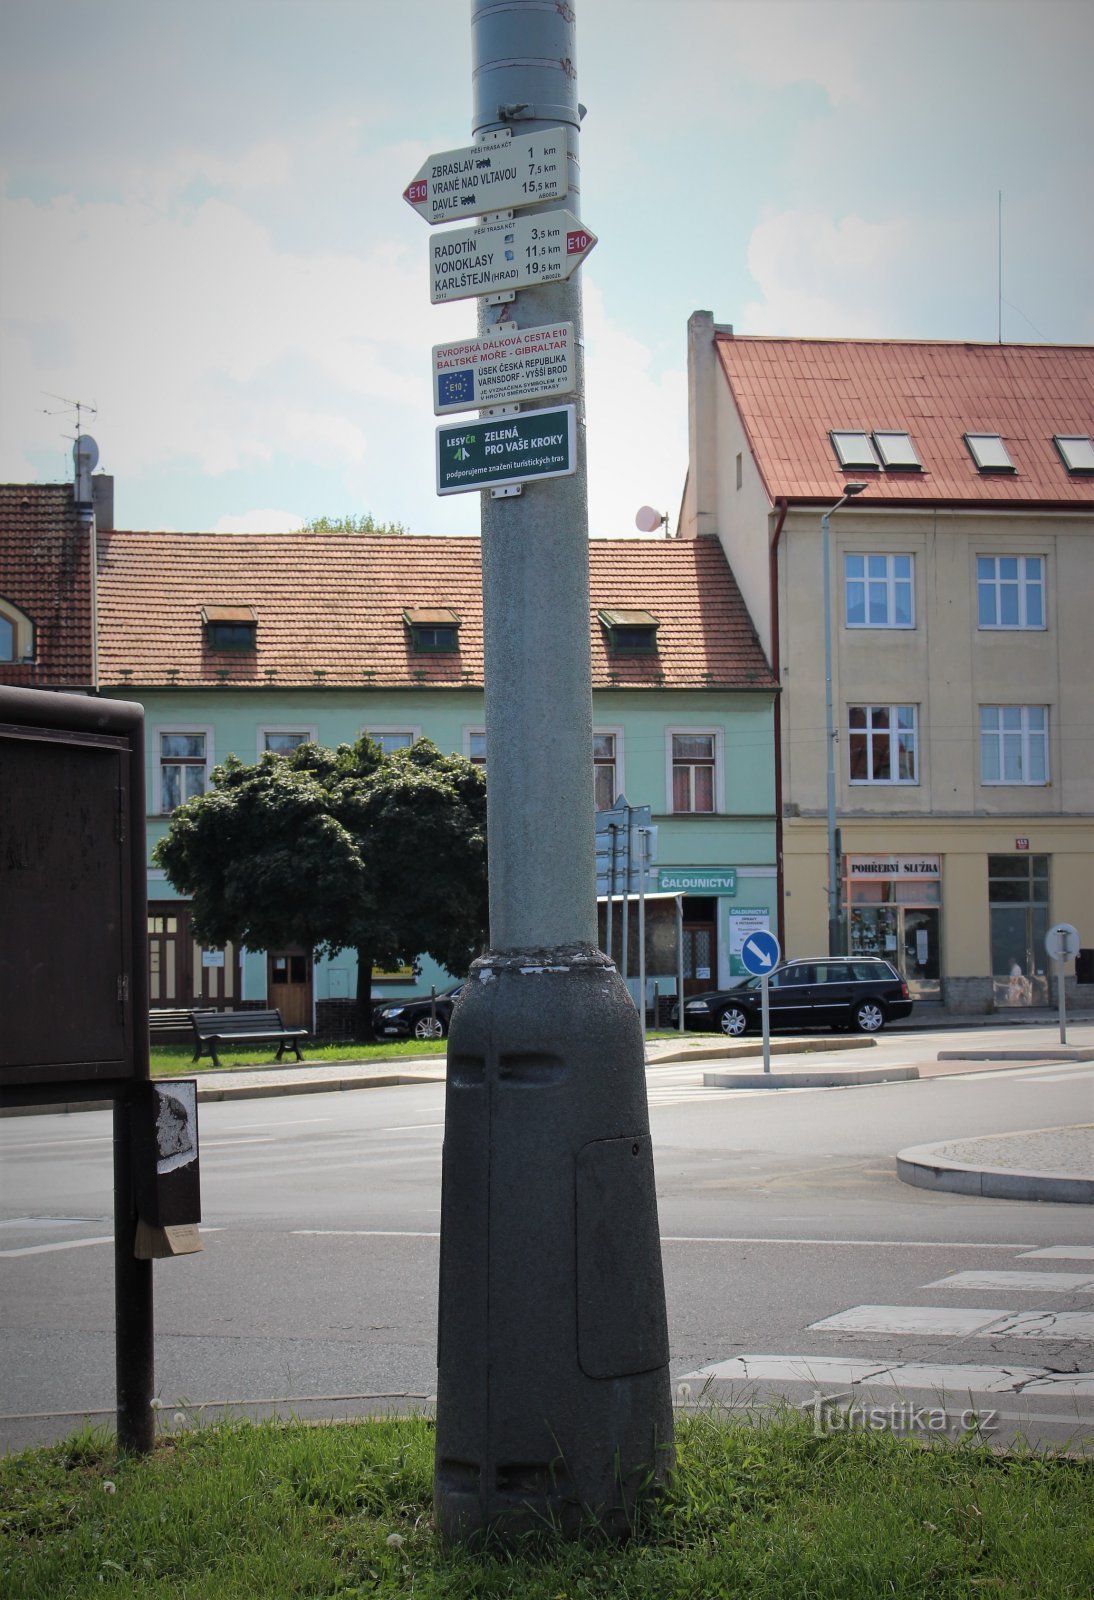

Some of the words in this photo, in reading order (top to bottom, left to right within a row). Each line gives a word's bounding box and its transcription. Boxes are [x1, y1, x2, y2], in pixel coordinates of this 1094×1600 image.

[483, 143, 501, 152] TRASA
[528, 147, 533, 158] 1
[543, 147, 556, 155] km
[432, 159, 474, 178] ZBRASLAV
[528, 163, 542, 175] 7,5
[544, 164, 556, 173] km
[432, 176, 460, 195] VRANÉ
[461, 175, 479, 189] NAD
[480, 167, 517, 185] VLTAVOU
[522, 180, 542, 193] 15,5
[544, 181, 557, 189] km
[409, 185, 427, 199] E10
[432, 196, 458, 211] DAVLE
[487, 225, 504, 233] TRASA
[531, 228, 546, 240] 3,5
[547, 229, 560, 237] km
[434, 238, 477, 259] RADOTÍN
[567, 236, 587, 250] E10
[525, 244, 546, 258] 11,5
[548, 245, 561, 254] km
[435, 253, 494, 275] VONOKLASY
[525, 262, 546, 275] 19,5
[548, 263, 561, 271] km
[435, 271, 491, 292] KARLŠTEJN
[491, 268, 519, 283] (HRAD)
[437, 342, 481, 359] EVROPSKÁ
[524, 331, 551, 343] CESTA
[552, 328, 567, 338] E10
[437, 352, 478, 369] BALTSKÉ
[480, 350, 507, 362] MOŘE
[515, 340, 567, 356] GIBRALTAR
[478, 365, 498, 376] ÚSEK
[499, 359, 524, 373] ČESKÁ
[525, 354, 567, 368] REPUBLIKA
[478, 372, 520, 387] VARNSDORF
[525, 366, 546, 379] VYŠŠÍ
[547, 364, 568, 376] BROD
[449, 382, 462, 392] E10
[488, 384, 523, 394] VYZNAČENA
[523, 378, 555, 387] SYMBOLEM
[485, 392, 506, 400] HROTU
[484, 425, 519, 443] ZELENÁ
[484, 443, 504, 456] PRO
[505, 438, 529, 453] VAŠE
[530, 434, 564, 448] KROKY
[446, 467, 487, 480] podporujeme
[513, 454, 551, 469] turistických
[551, 455, 564, 463] tras
[851, 860, 899, 873] POHŘEBNÍ
[903, 860, 938, 873] SLUŽBA
[661, 875, 734, 889] ČALOUNICTVÍ
